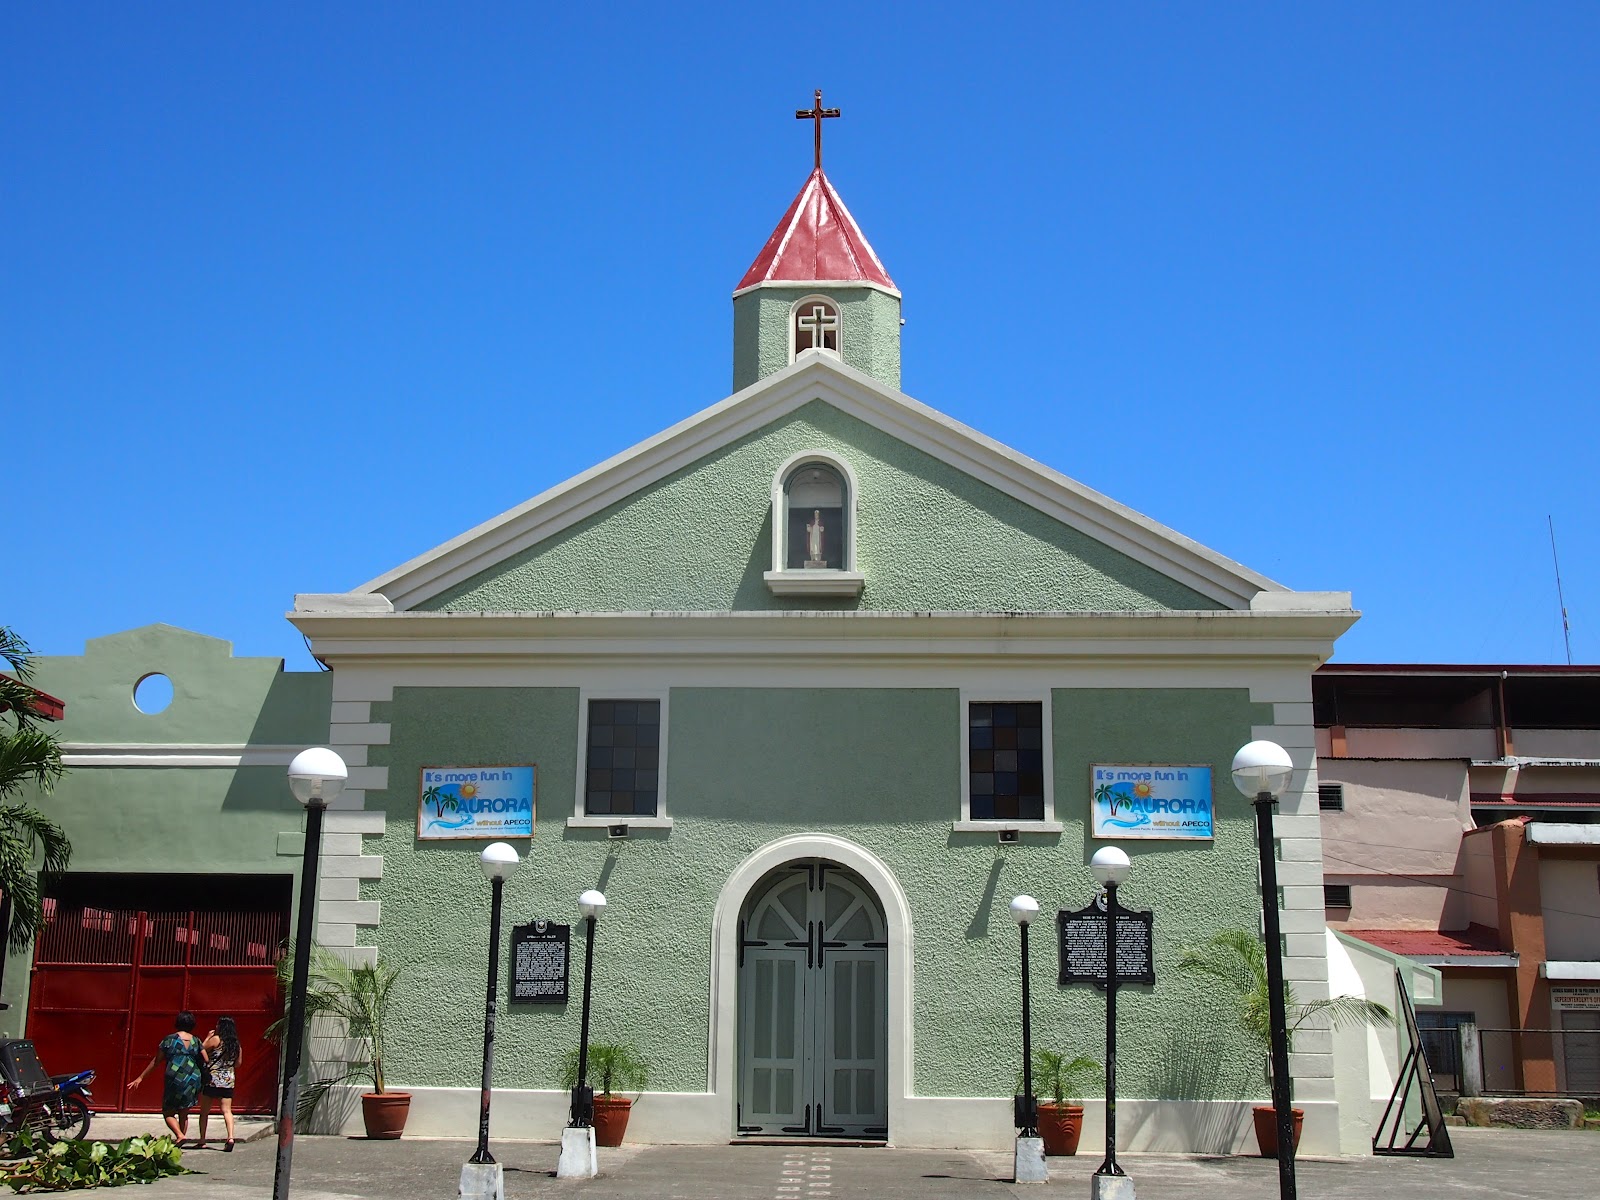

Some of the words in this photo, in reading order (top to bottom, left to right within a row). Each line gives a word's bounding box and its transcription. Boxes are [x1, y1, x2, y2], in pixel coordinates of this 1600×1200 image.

[425, 771, 442, 782] It's
[445, 773, 477, 782] more
[480, 771, 500, 781] fun
[502, 770, 512, 780] in
[1096, 769, 1114, 780] It's
[1117, 771, 1152, 781] more
[1155, 770, 1175, 781] fun
[1177, 770, 1188, 780] in
[455, 798, 531, 814] AURORA
[1130, 798, 1210, 814] AURORA
